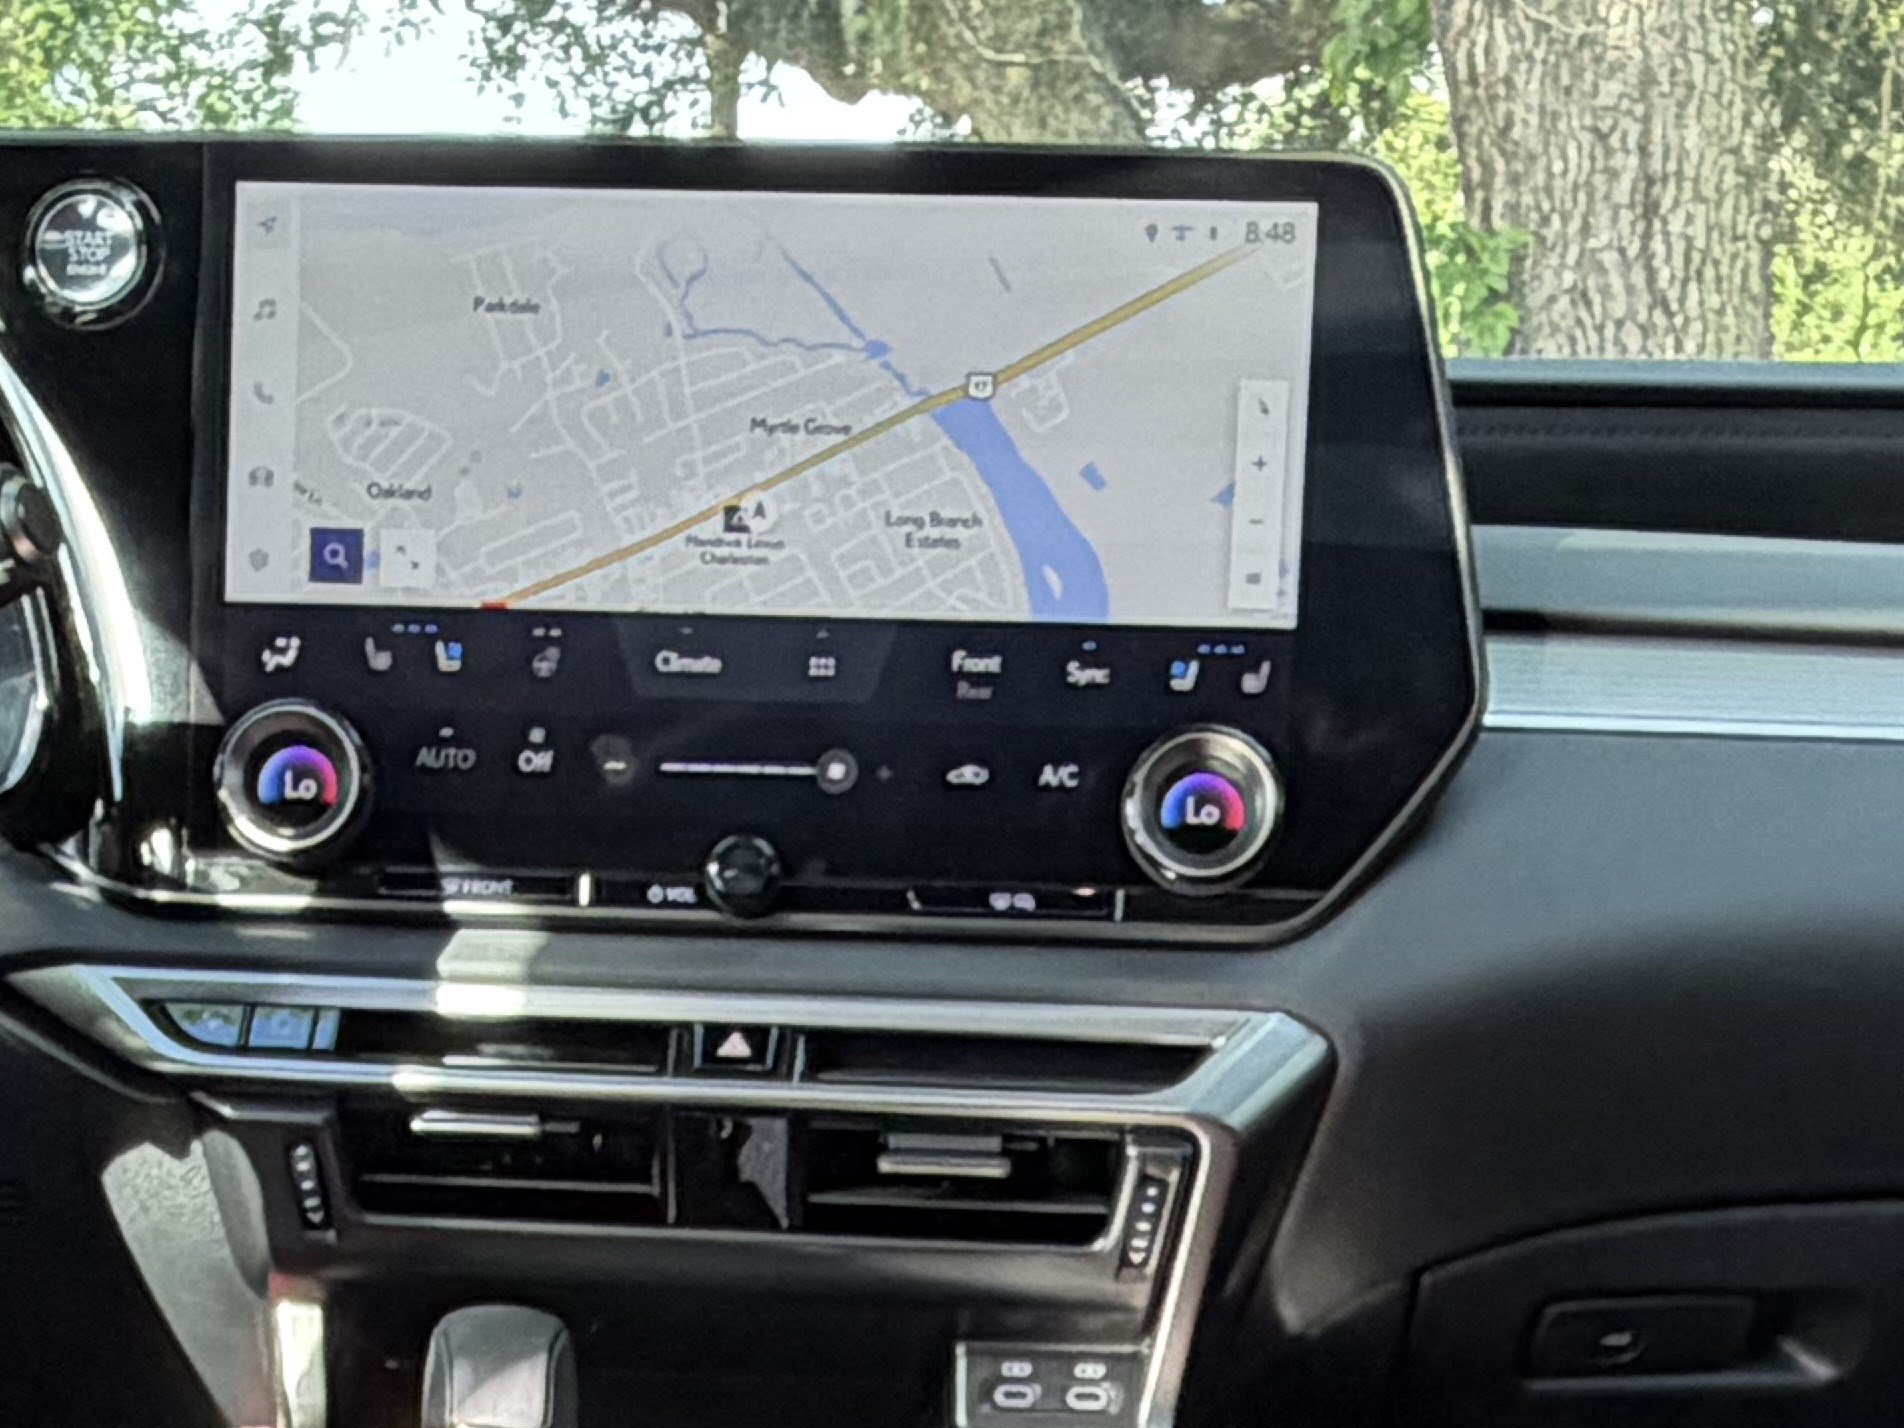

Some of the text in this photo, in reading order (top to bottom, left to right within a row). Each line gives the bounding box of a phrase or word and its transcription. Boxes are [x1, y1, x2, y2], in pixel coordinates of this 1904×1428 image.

[64, 230, 112, 247] START
[68, 247, 111, 262] STOP
[473, 296, 541, 313] Parkdale
[750, 416, 852, 437] Myrtle Grove
[366, 481, 432, 502] Oakland
[884, 509, 983, 531] Long Branch
[905, 530, 961, 549] Estates
[654, 649, 723, 674] Climate
[950, 648, 1003, 674] Front
[1065, 660, 1111, 687] Sync
[415, 745, 477, 770] AUTO
[516, 748, 555, 773] Off
[284, 768, 318, 801] Lo
[1037, 764, 1080, 788] A/C
[1185, 795, 1221, 826] Lo
[666, 886, 697, 904] VOL
